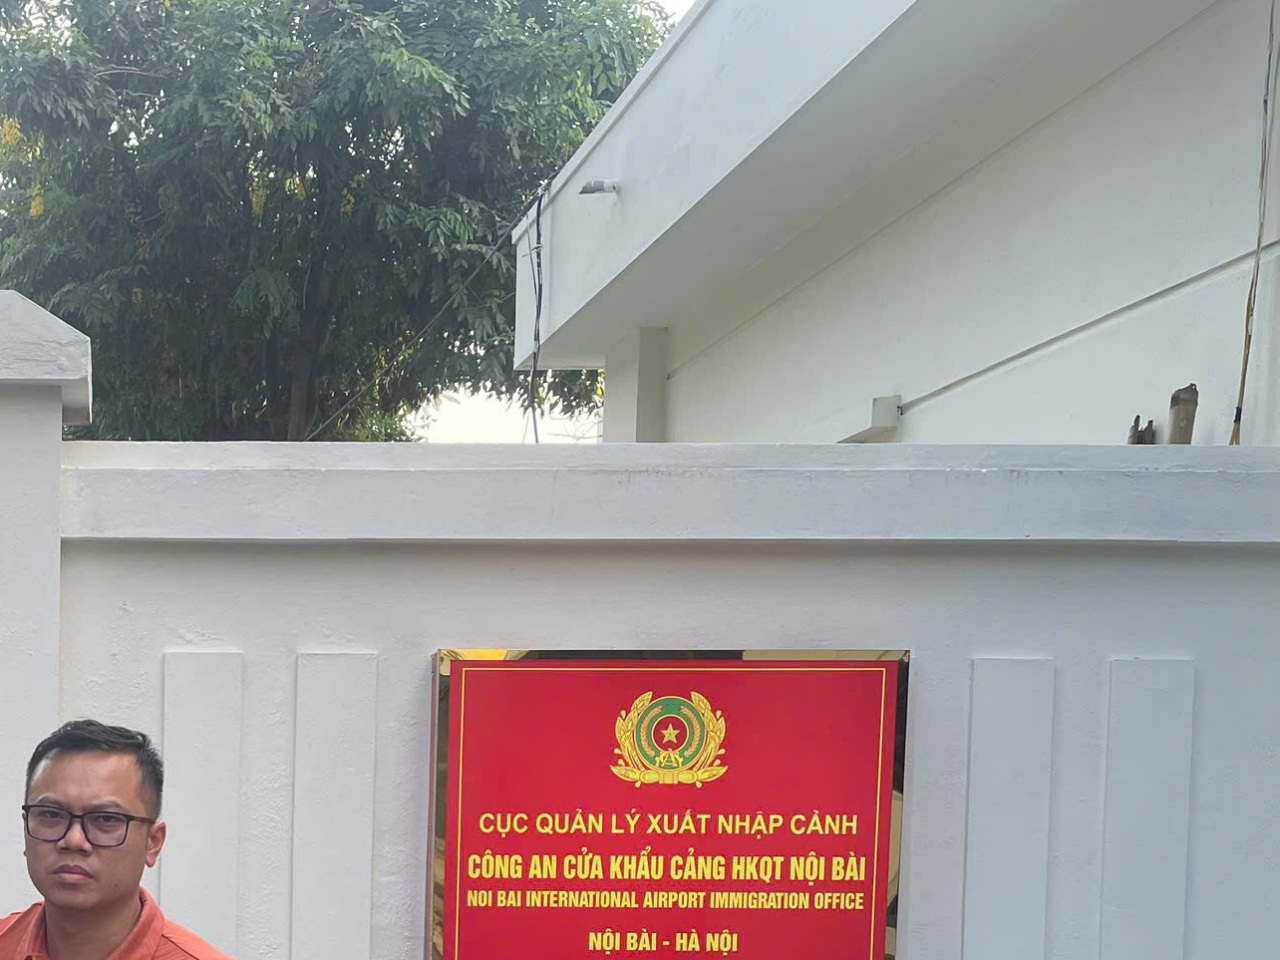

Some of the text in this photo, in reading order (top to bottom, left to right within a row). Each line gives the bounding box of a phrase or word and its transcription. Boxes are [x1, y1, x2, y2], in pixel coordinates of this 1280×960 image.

[479, 808, 858, 839] CỤC QUẢN LÝ XUẤT NHẬP CẢNH
[468, 845, 866, 886] CÔNG AN CỬA KHẨU CẢNG HKQT NỘI BÀI
[467, 890, 864, 910] NOI BAI INTERNATIONAL AIRPORT IMMIGRATION OFFICE
[589, 928, 620, 954] NỘI
[626, 928, 657, 951] BÀI
[675, 928, 701, 951] HÀ
[706, 929, 738, 955] NỘI
